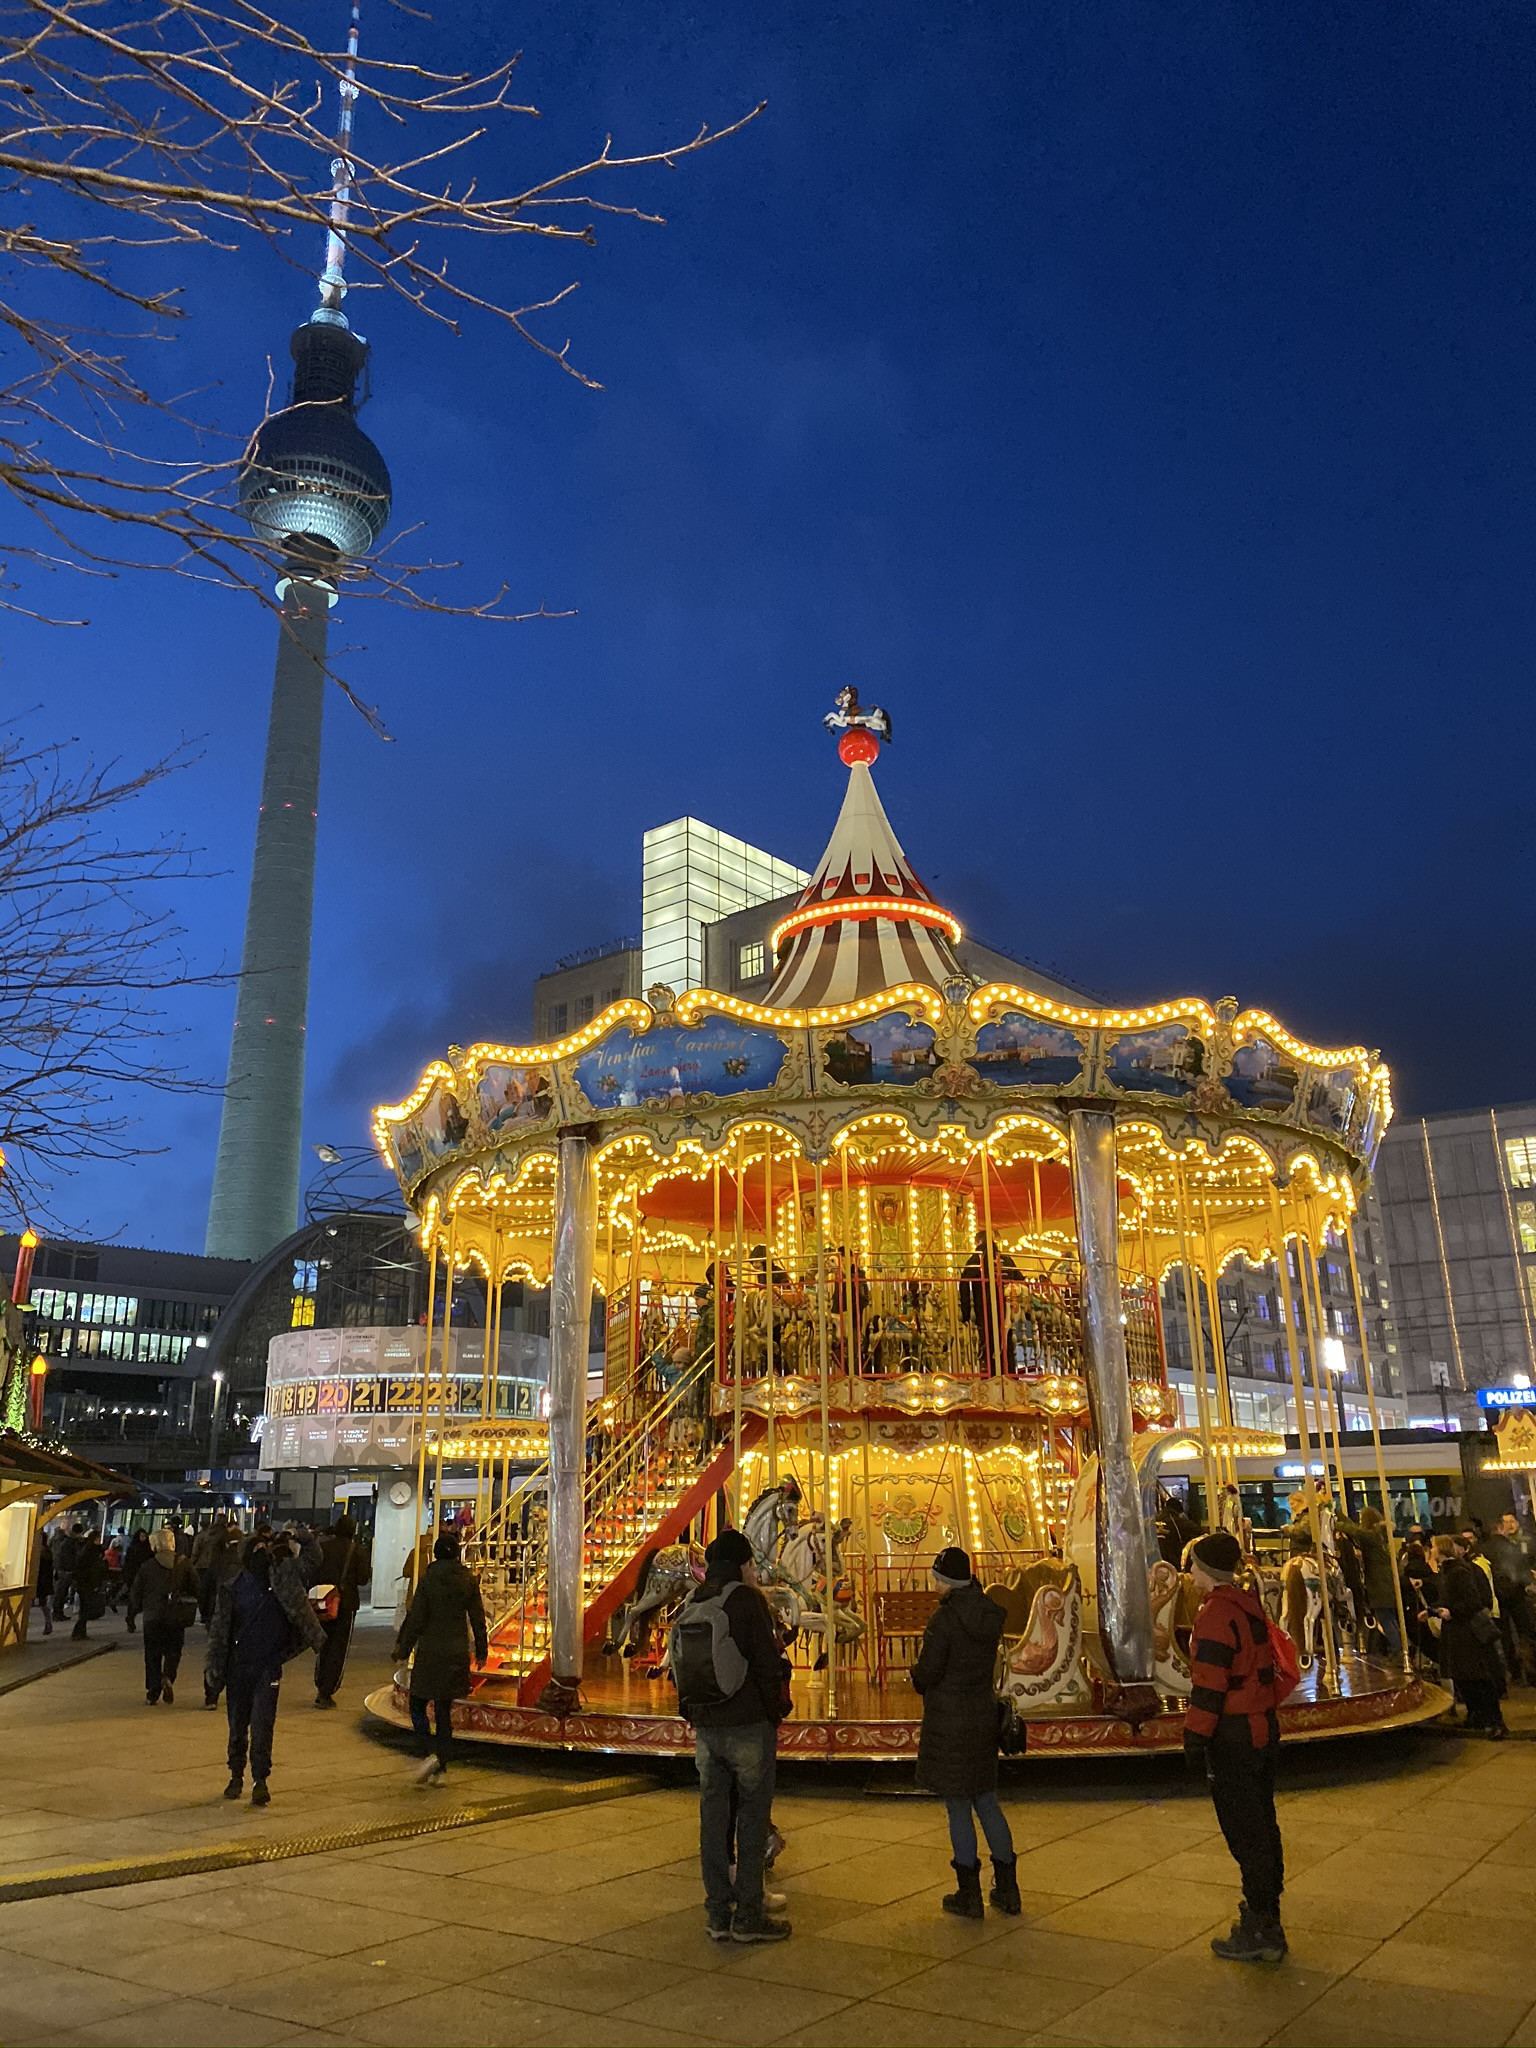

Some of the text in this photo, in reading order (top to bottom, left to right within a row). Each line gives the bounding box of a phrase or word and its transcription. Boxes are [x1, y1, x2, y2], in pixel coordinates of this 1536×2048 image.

[297, 1385, 317, 1408] 19
[319, 1384, 349, 1407] 20
[354, 1382, 381, 1406] 21
[388, 1382, 422, 1405] 22
[427, 1383, 458, 1405] 23
[499, 1385, 508, 1408] 1
[520, 1387, 529, 1409] 2
[1486, 1388, 1536, 1404] POLIZEI
